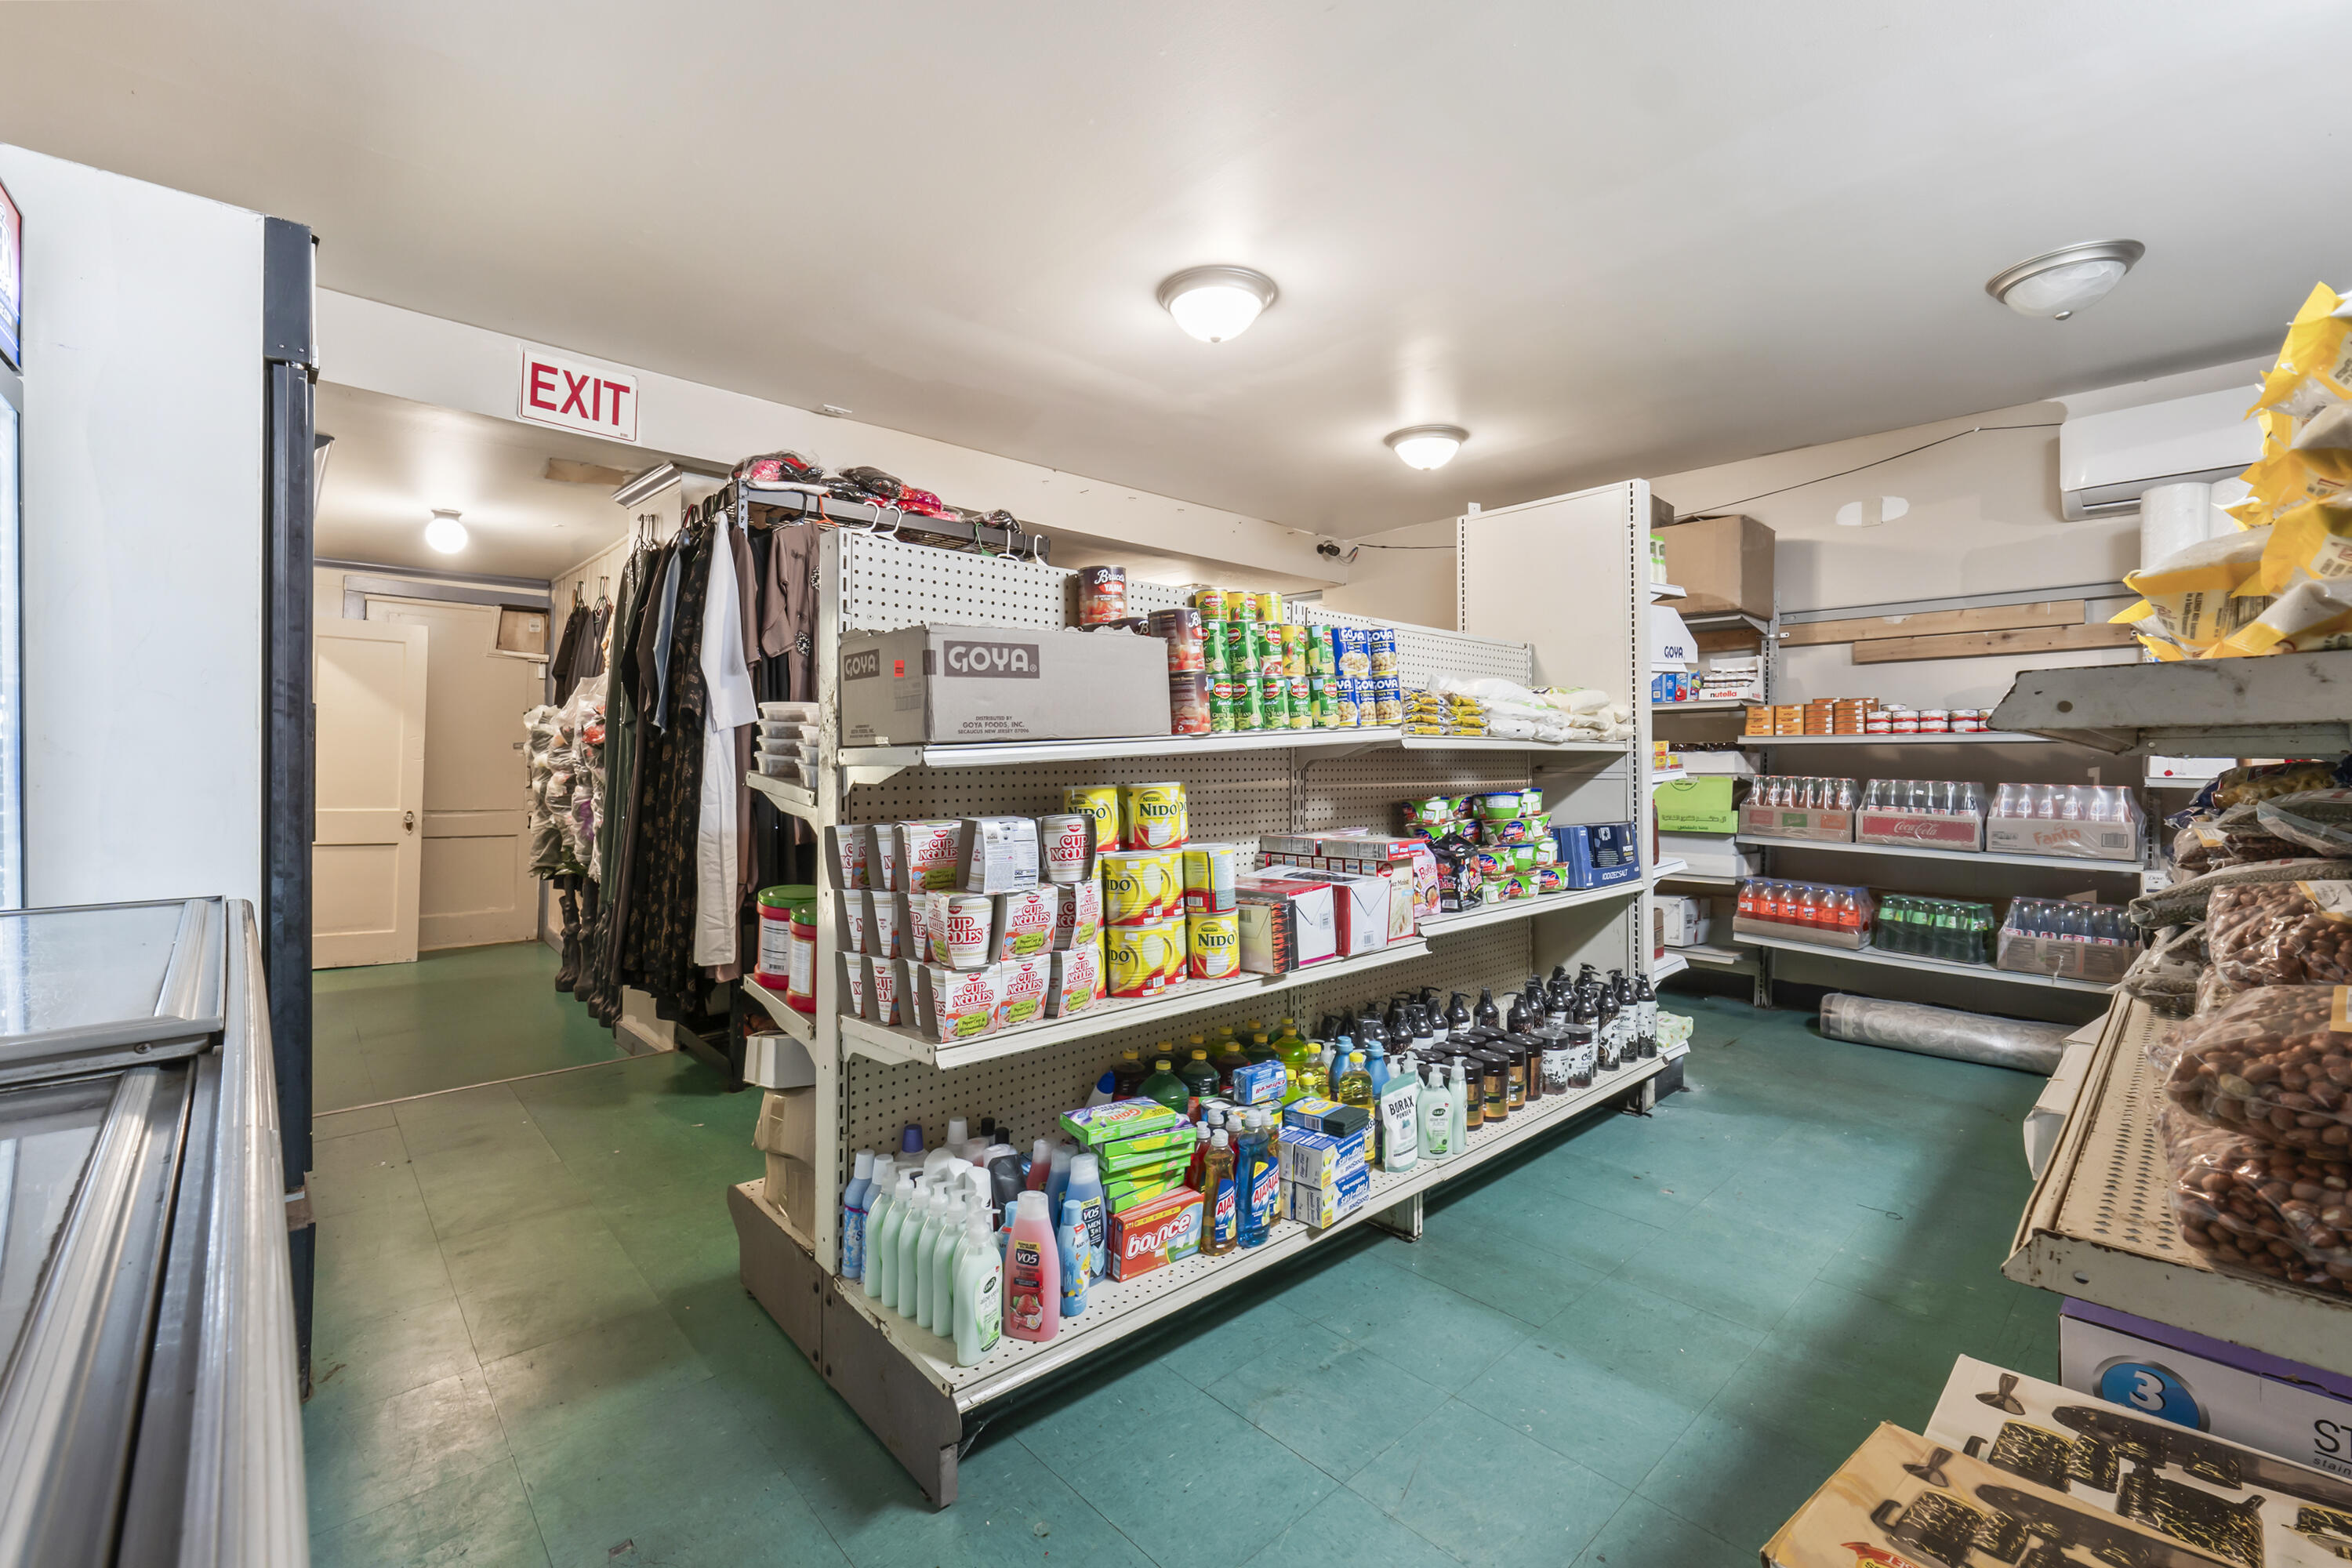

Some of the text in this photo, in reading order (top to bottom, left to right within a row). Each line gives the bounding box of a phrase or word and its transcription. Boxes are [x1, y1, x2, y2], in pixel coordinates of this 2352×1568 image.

[530, 361, 630, 426] EXIT
[1104, 583, 1123, 593] YAMS
[948, 645, 1029, 673] GOYA
[1664, 645, 1683, 659] GOYA
[846, 654, 877, 677] GOYA
[1710, 690, 1737, 699] nutella
[1139, 802, 1178, 817] NIDO
[1060, 834, 1089, 848] CUP
[2032, 828, 2082, 846] Fanta
[928, 839, 954, 850] CUP
[918, 847, 959, 861] NOODLES
[1022, 904, 1044, 916] CUP
[1011, 913, 1051, 927] NOODLES
[1197, 933, 1236, 947] NIDO
[1074, 960, 1089, 972] CUP
[1016, 971, 1037, 984] CUP
[1067, 967, 1095, 985] NOODLES
[963, 982, 987, 995] CUP
[1007, 979, 1044, 996] NOODLES
[952, 989, 994, 1008] NOODLES
[1388, 1094, 1415, 1116] BORAX
[1110, 1108, 1142, 1121] Gain
[1396, 1109, 1412, 1120] POWDER
[1338, 1144, 1364, 1167] Flap-Ties
[1254, 1181, 1269, 1203] AJAX
[1341, 1181, 1368, 1206] Flap-Ties
[1217, 1194, 1234, 1216] AJAX
[1083, 1207, 1099, 1221] VO5
[1087, 1221, 1101, 1229] MEN
[1126, 1214, 1191, 1259] bounce
[1017, 1251, 1038, 1264] VO5
[2128, 1370, 2167, 1412] 3
